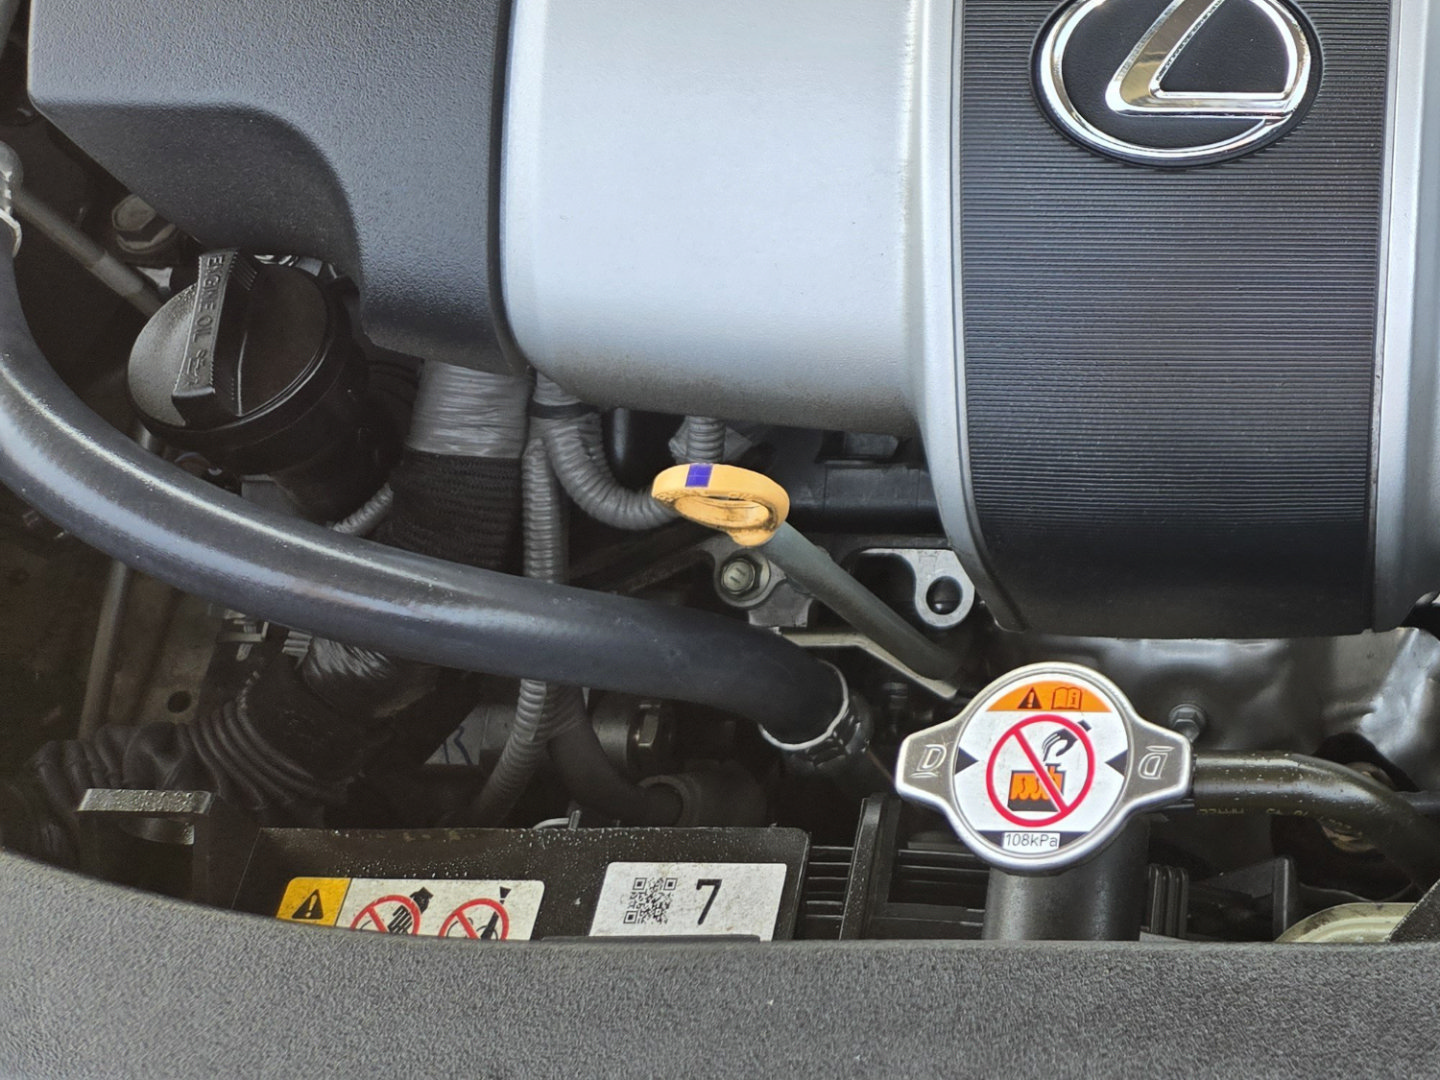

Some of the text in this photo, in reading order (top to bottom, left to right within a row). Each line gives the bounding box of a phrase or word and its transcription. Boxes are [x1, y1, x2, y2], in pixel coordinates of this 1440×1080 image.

[193, 254, 225, 343] ENGINE OIL
[1005, 833, 1058, 848] 108kPa
[696, 878, 723, 926] 7
